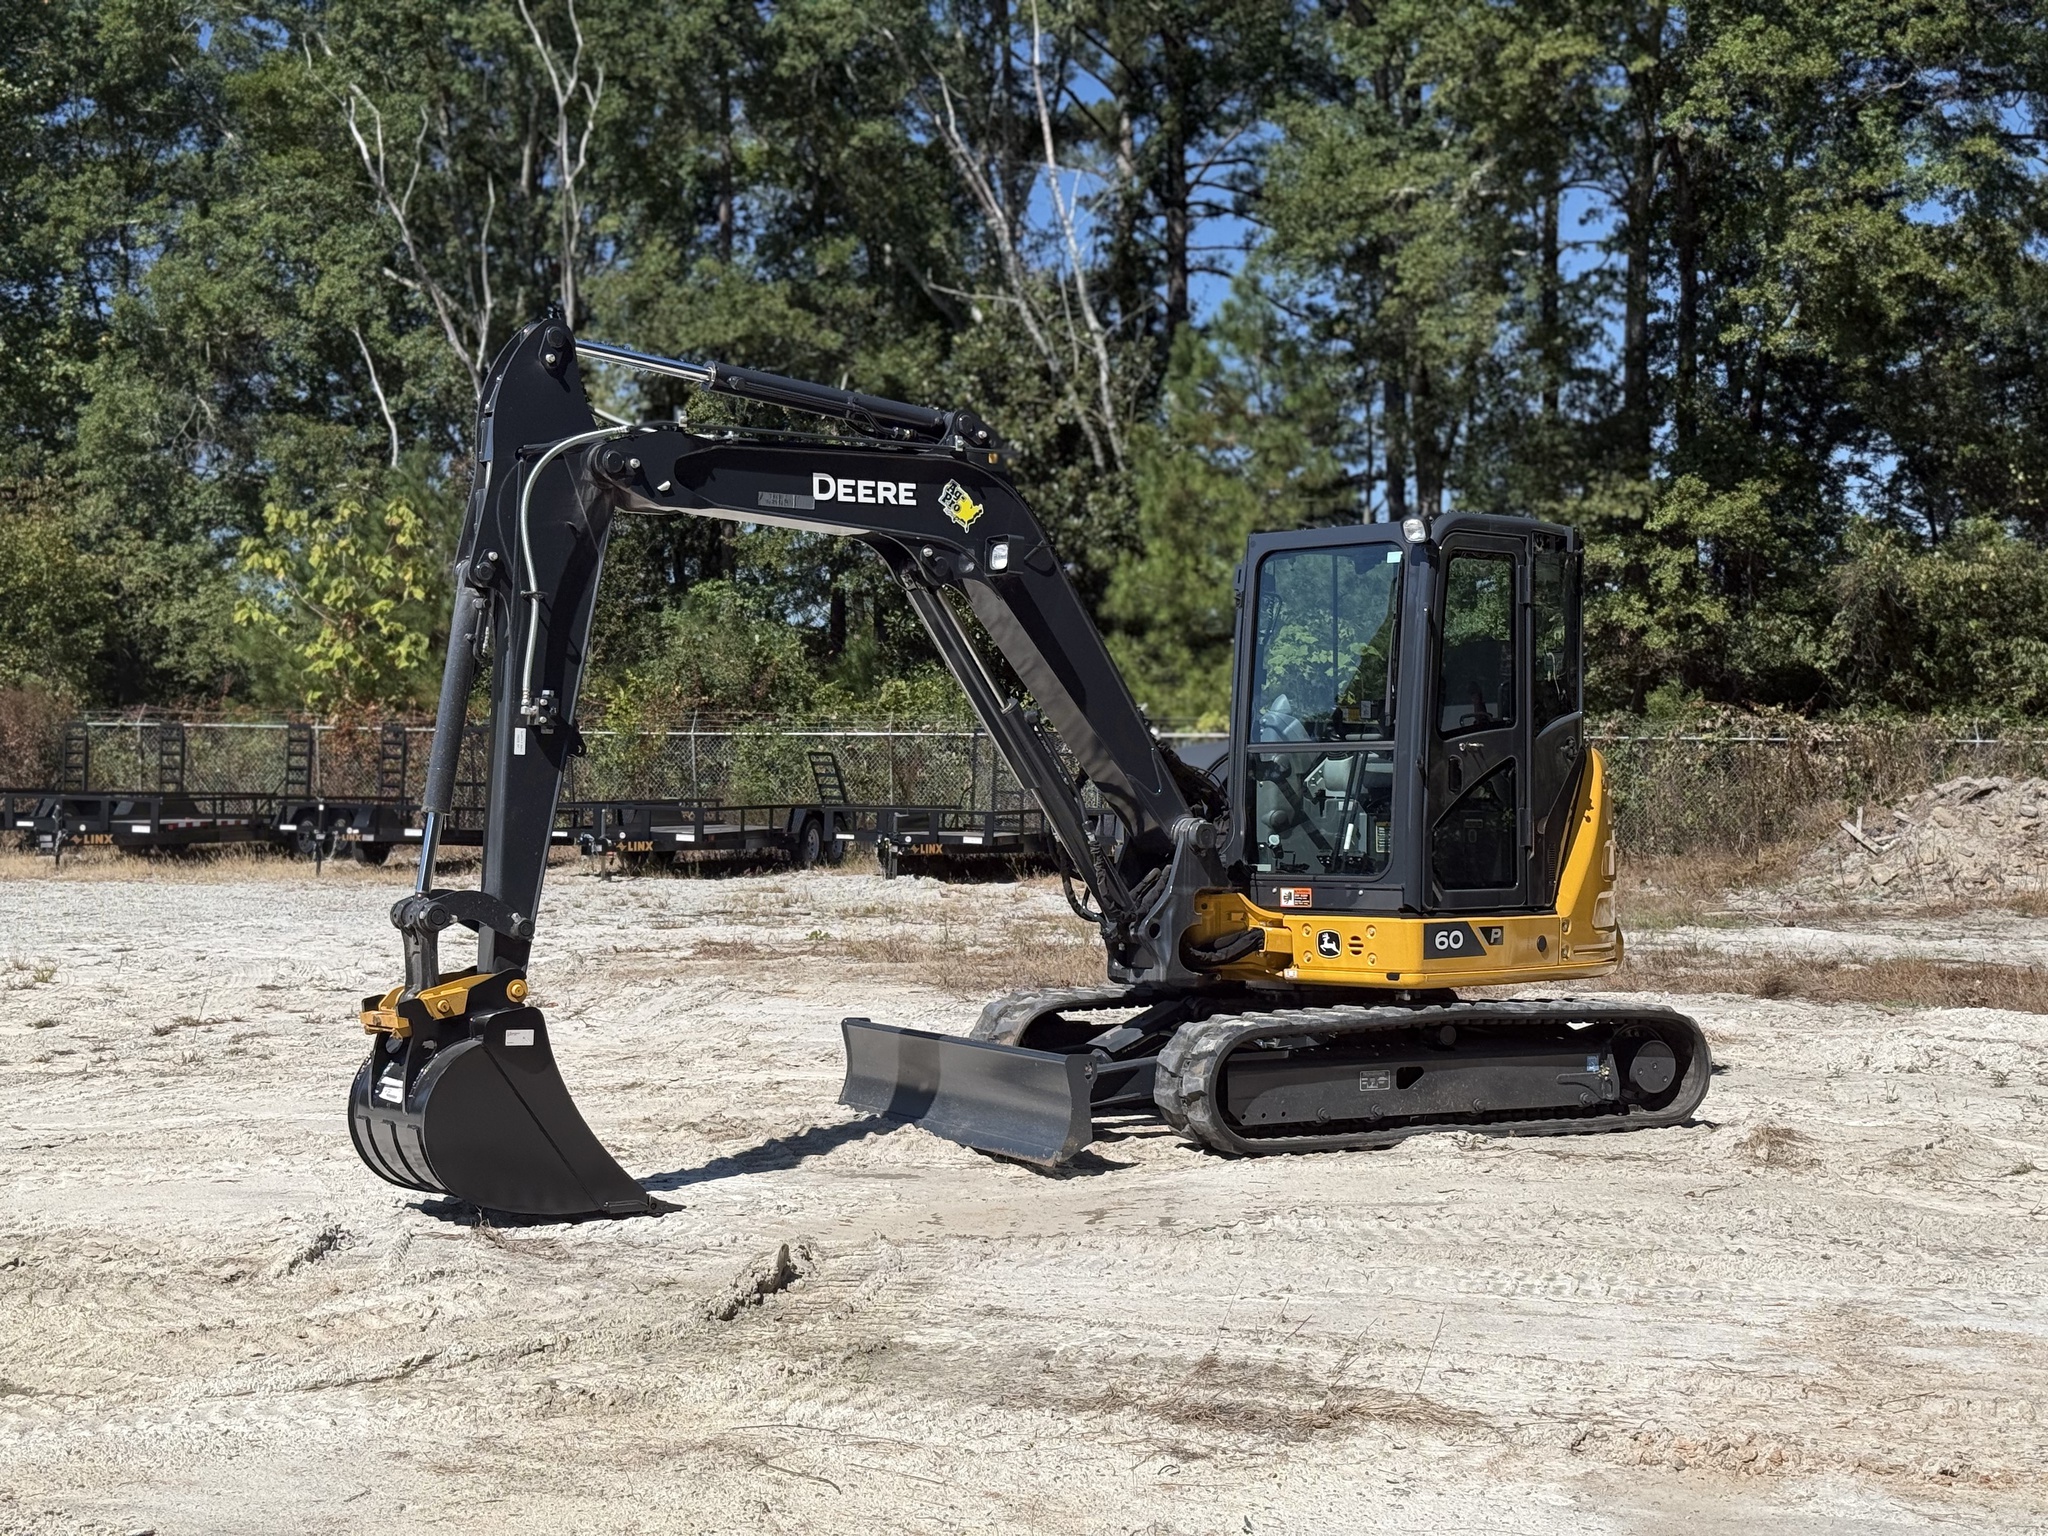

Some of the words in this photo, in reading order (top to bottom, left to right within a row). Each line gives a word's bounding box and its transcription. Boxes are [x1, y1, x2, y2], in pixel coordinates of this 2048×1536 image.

[812, 472, 917, 506] DEERE
[942, 492, 961, 512] Pro
[83, 834, 114, 844] LINX
[341, 833, 361, 841] LINX
[627, 841, 654, 852] LINX
[920, 843, 943, 854] LINX
[1434, 929, 1464, 950] 60
[1490, 928, 1502, 943] P
